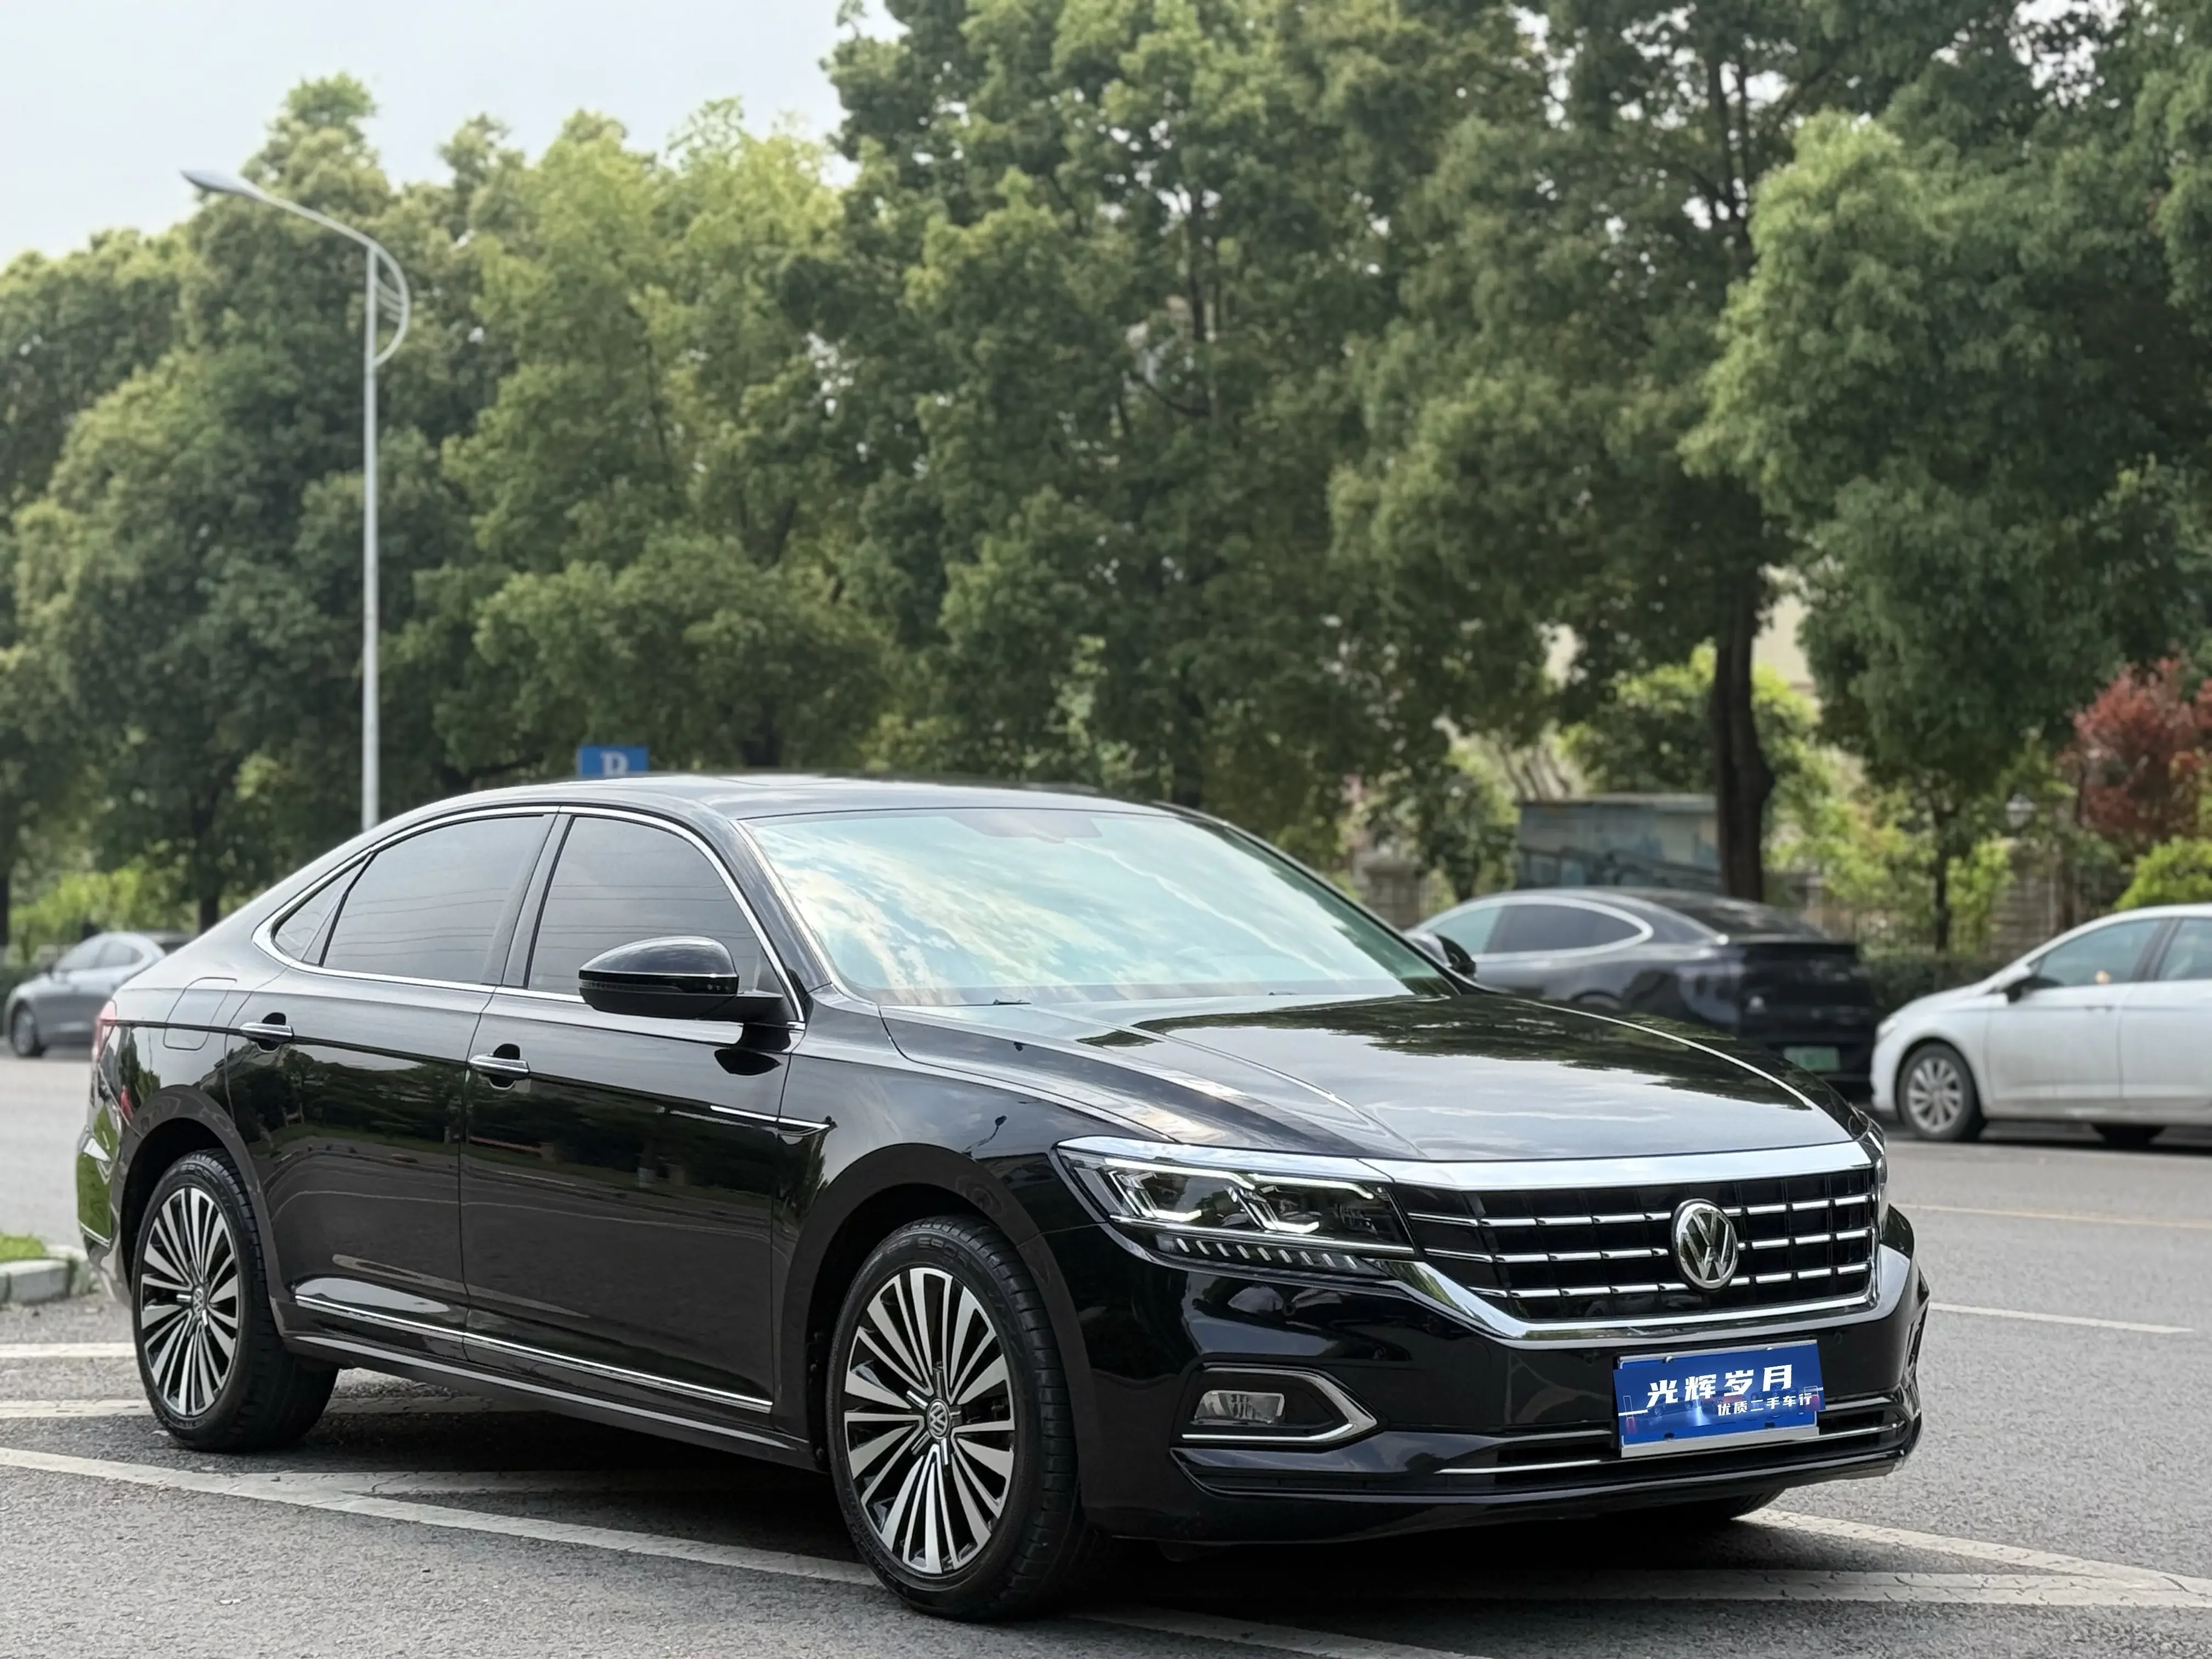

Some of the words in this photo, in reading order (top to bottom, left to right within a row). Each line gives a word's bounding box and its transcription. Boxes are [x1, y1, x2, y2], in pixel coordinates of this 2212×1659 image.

[1646, 1364, 1793, 1408] 光辉岁月
[1717, 1392, 1813, 1417] 优质二手车行
